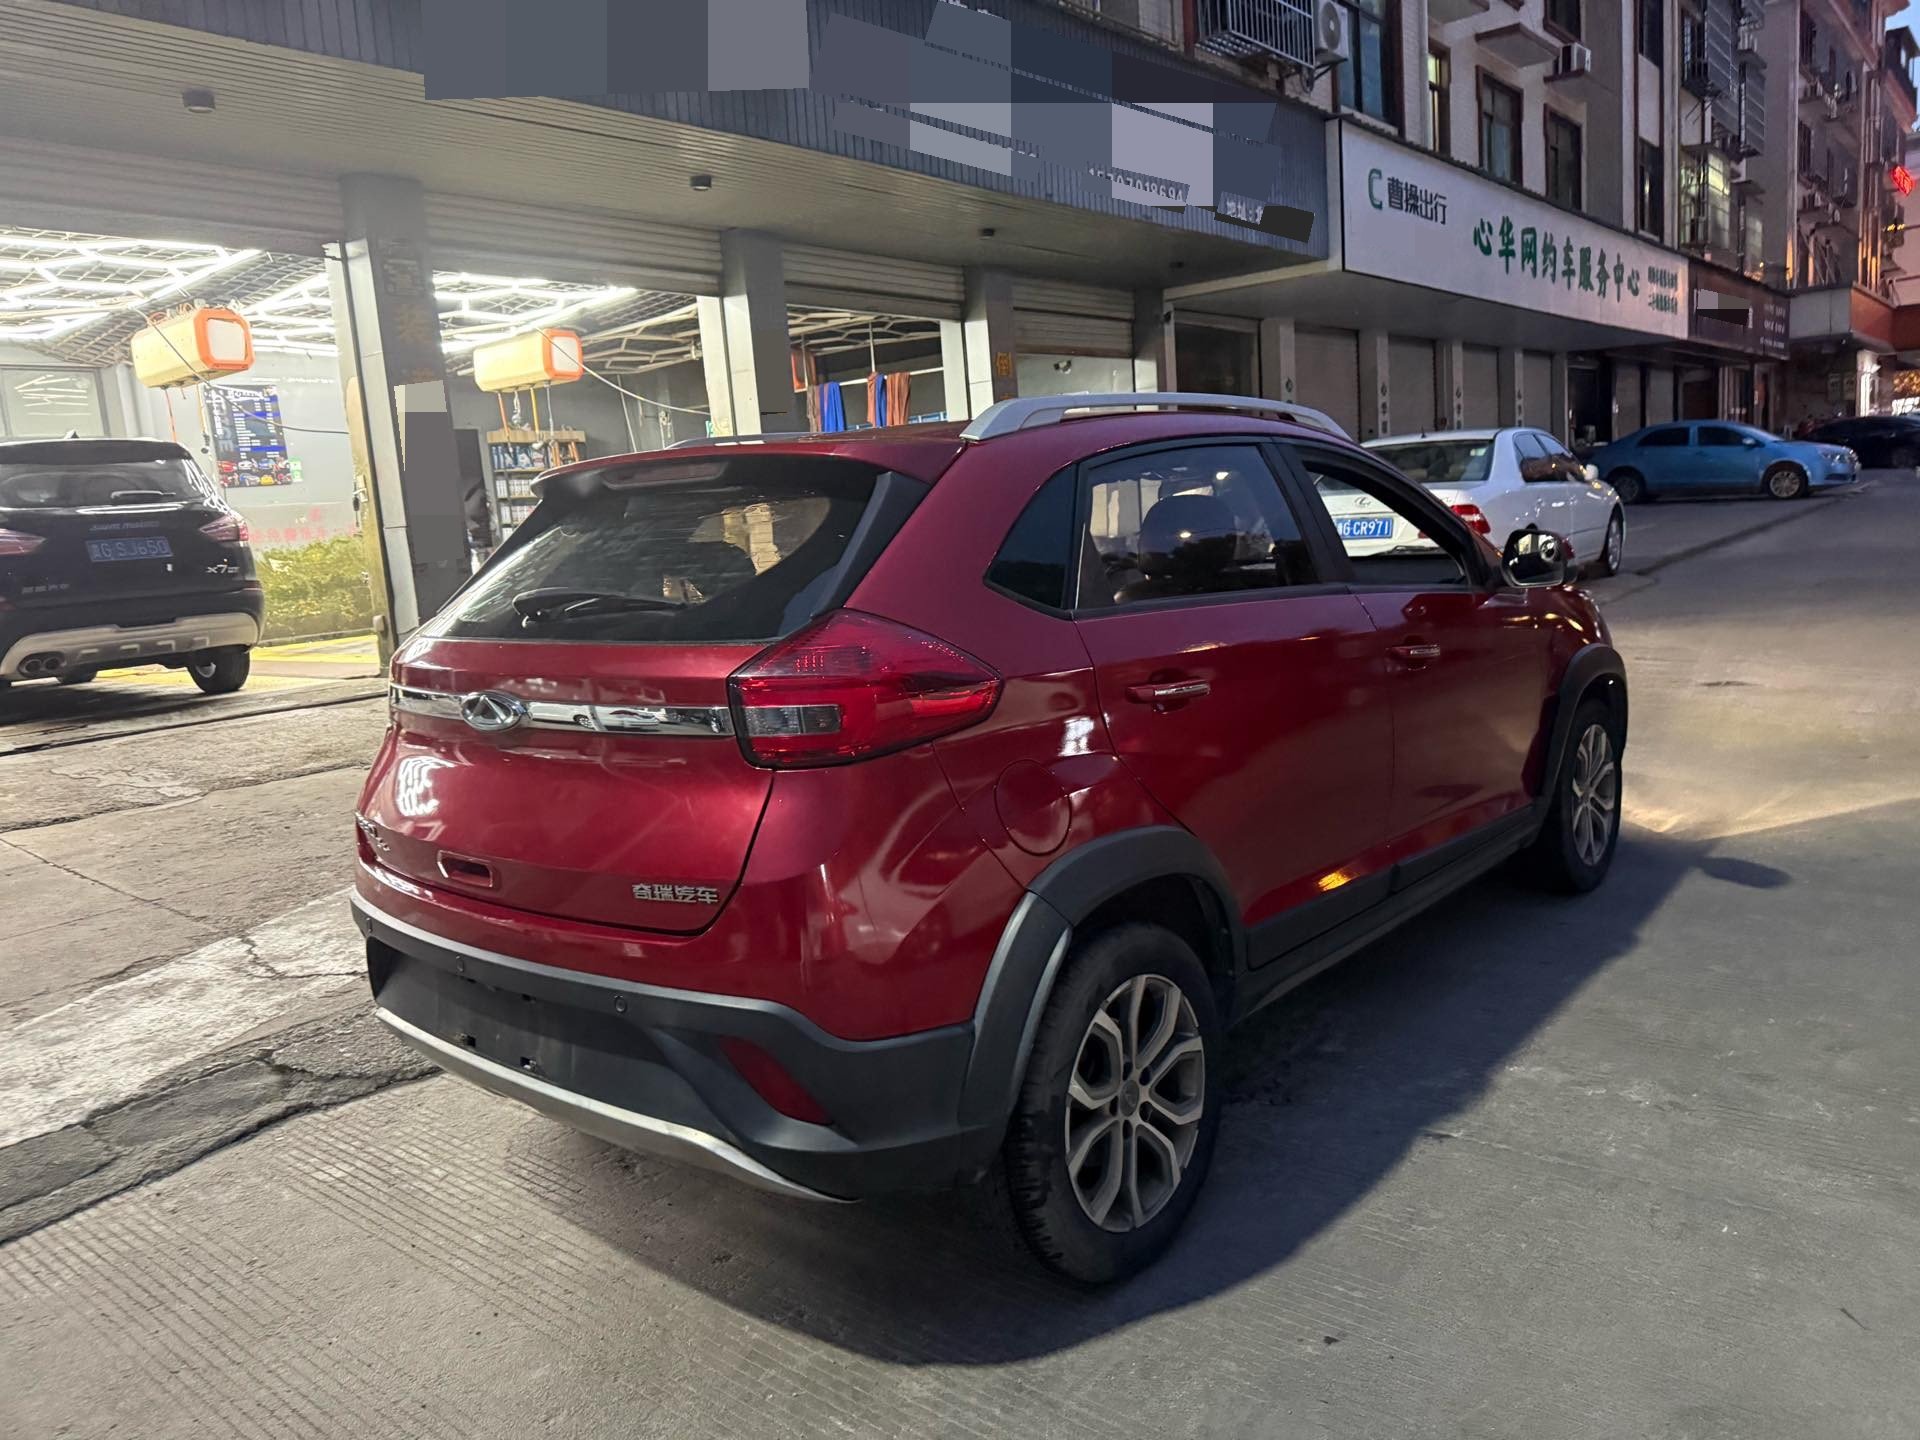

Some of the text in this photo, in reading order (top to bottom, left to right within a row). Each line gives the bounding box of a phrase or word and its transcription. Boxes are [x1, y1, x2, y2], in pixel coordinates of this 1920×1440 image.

[1387, 176, 1448, 225] 曹操出行
[1473, 215, 1640, 303] 心华网约车服务中心
[632, 883, 719, 904] 奇瑞汽车
